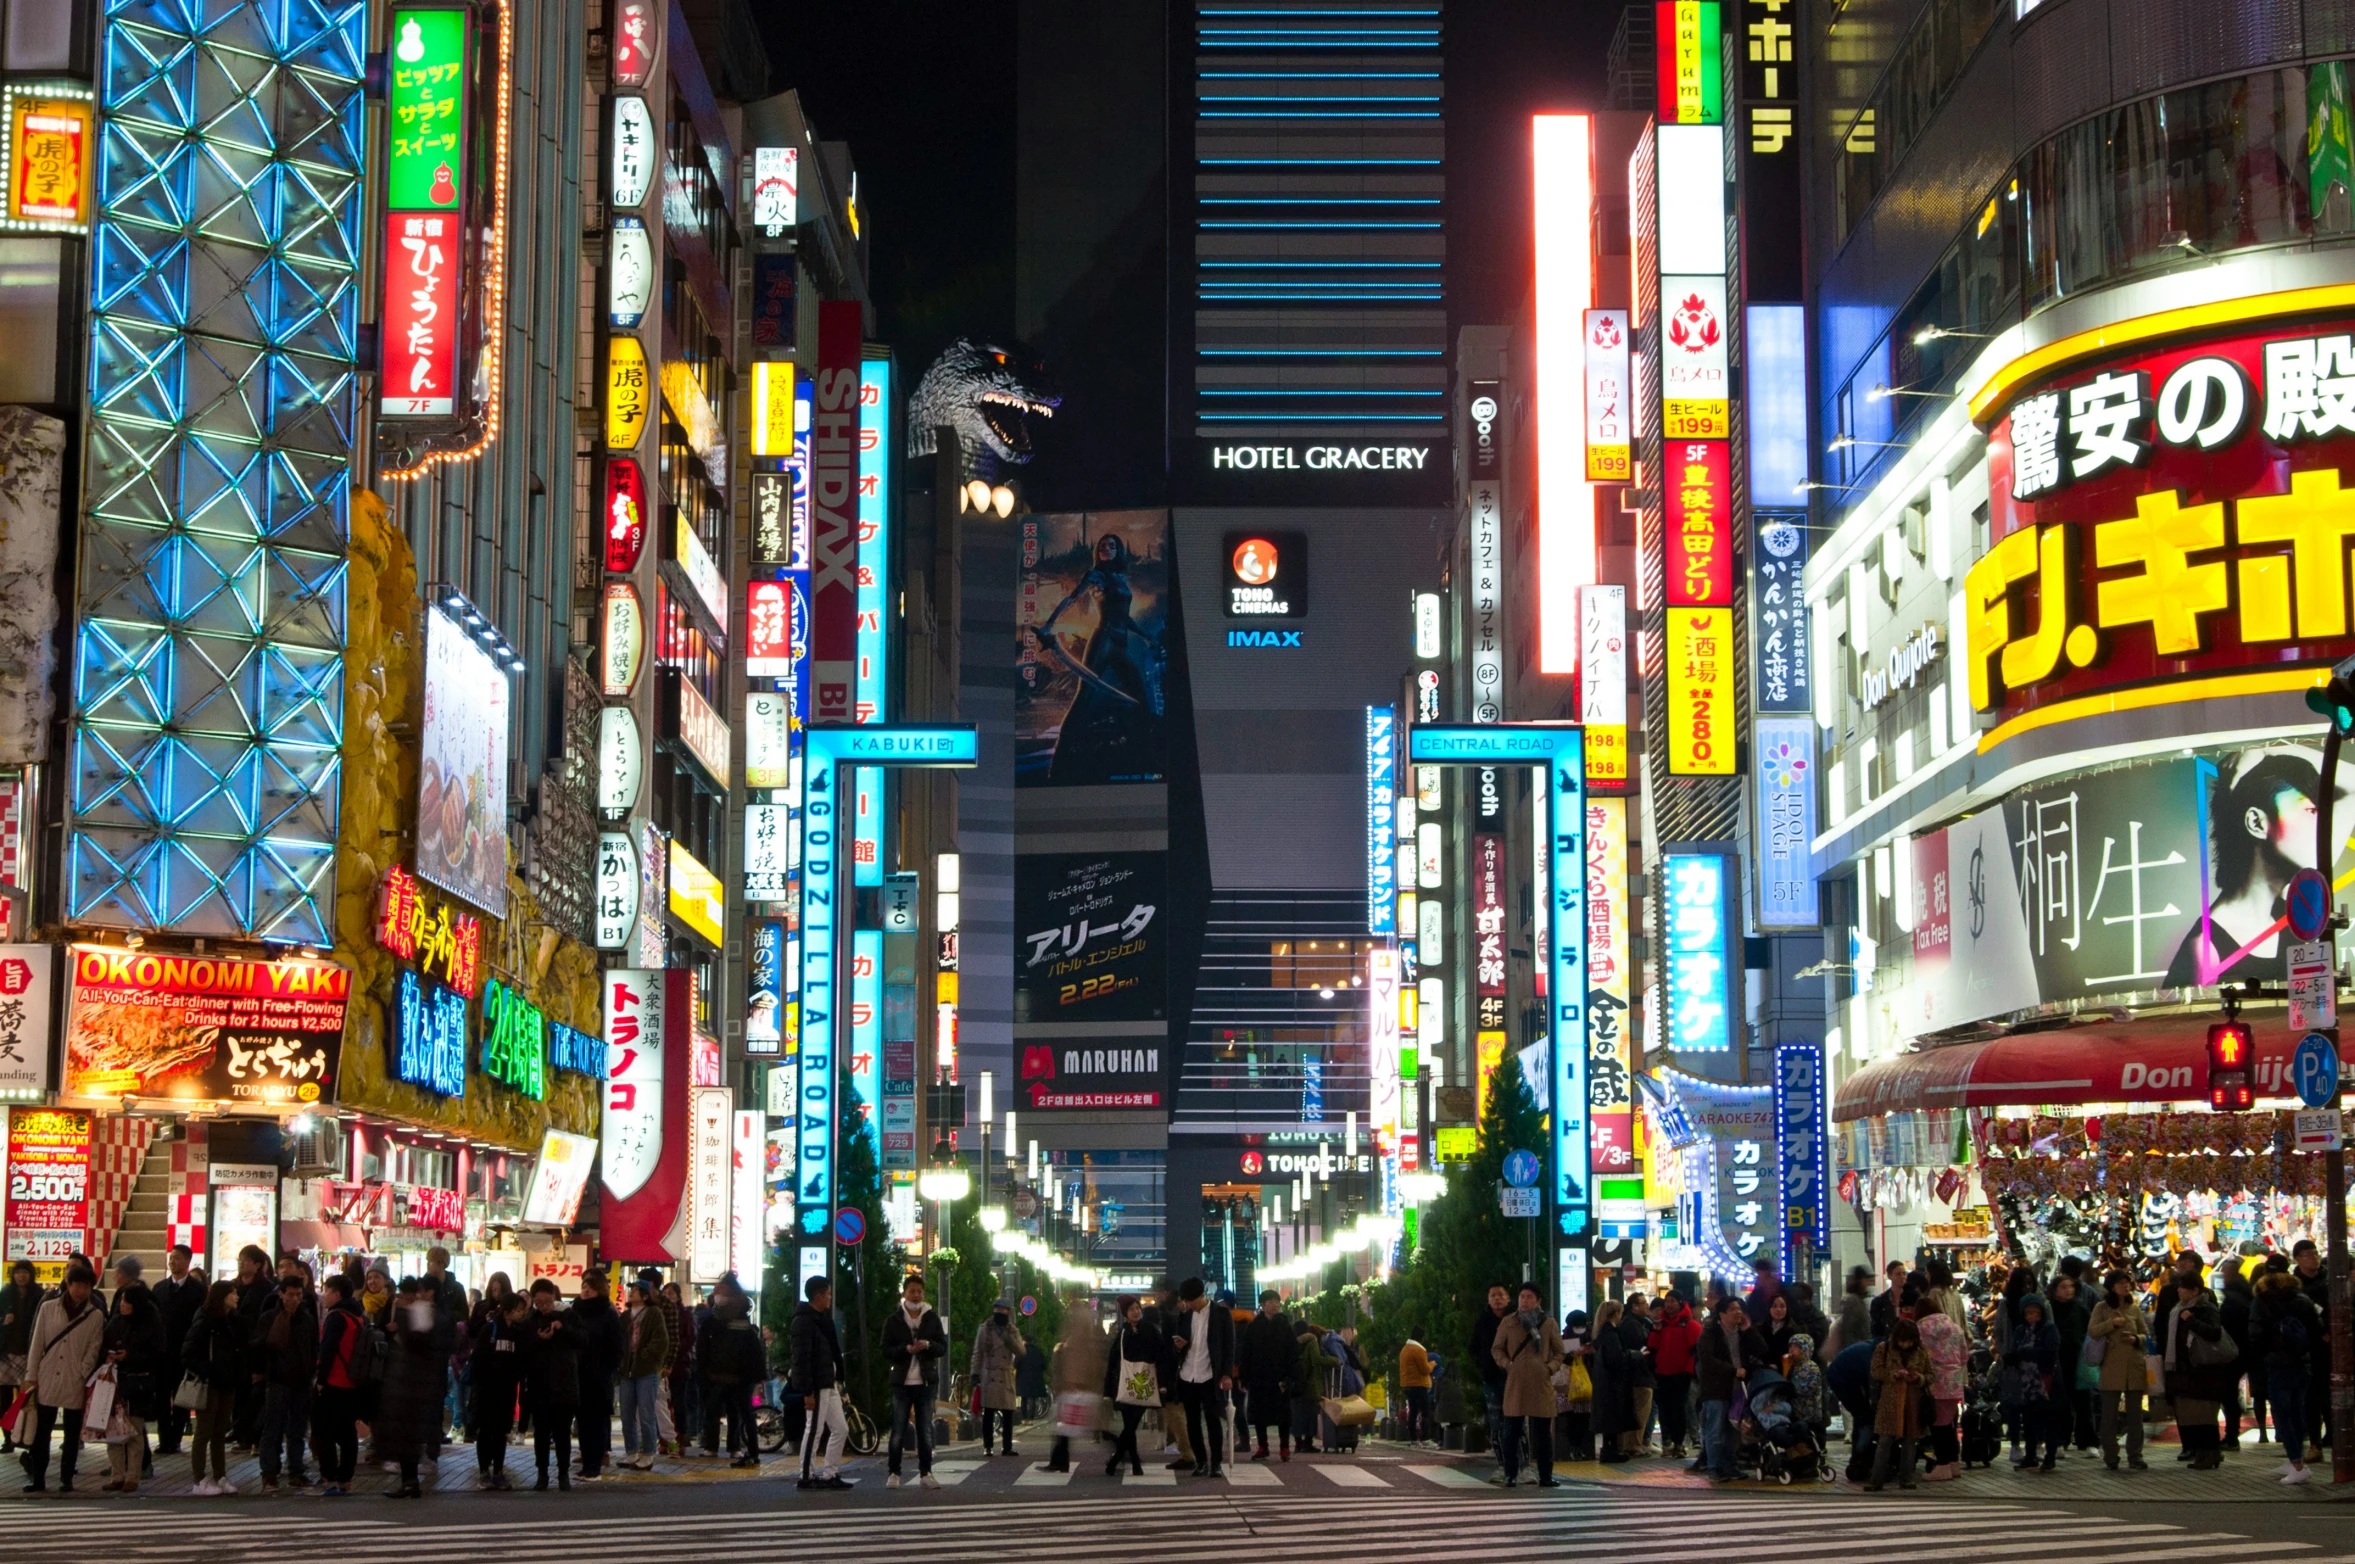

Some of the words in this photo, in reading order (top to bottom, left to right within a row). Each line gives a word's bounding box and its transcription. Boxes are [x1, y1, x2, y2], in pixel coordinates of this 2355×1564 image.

[619, 73, 641, 83] 7F
[420, 87, 432, 100] と
[18, 100, 49, 113] 4F
[397, 98, 455, 123] サラダ
[419, 122, 432, 134] と
[395, 133, 457, 157] スイーツ
[33, 138, 64, 193] 虎の子
[615, 188, 641, 204] 6F
[405, 219, 443, 237] 新宿
[766, 225, 783, 237] 8F
[401, 238, 445, 393] ひょうたん
[617, 315, 634, 325] 5F
[1670, 367, 1722, 383] 鳥メロ
[408, 400, 430, 412] 7F
[614, 368, 644, 423] 虎の子
[1598, 379, 1618, 439] 鳥メロ
[1670, 403, 1722, 415] 生ビール
[2011, 334, 2355, 500] 驚安の殿
[1678, 418, 1713, 434] 199
[611, 434, 631, 445] 4F
[1591, 447, 1626, 456] 生ビール
[1213, 447, 1300, 470] HOTEL
[1306, 447, 1429, 470] GRACERY
[1595, 457, 1627, 470] 199
[1686, 445, 1707, 462] 5F
[817, 368, 858, 594] SHIDAX
[756, 477, 783, 549] 山内農場
[632, 528, 641, 552] 3F
[1680, 465, 1715, 600] 豊後高田どり
[763, 551, 777, 560] 5F
[1232, 588, 1273, 601] TOHO
[1609, 589, 1623, 599] 4F
[1232, 602, 1289, 613] CINEMAS
[855, 384, 880, 862] カラオケ&パーテー館
[1762, 561, 1789, 701] かんかん商店
[613, 602, 630, 684] お好み焼き
[1228, 631, 1301, 647] IMAX
[1685, 636, 1718, 683] 酒場
[1863, 664, 1886, 711] Don
[1889, 622, 1939, 689] Quijote
[1480, 669, 1495, 679] 8F
[1689, 689, 1713, 699] 全品
[1481, 708, 1496, 719] 5F
[1691, 701, 1712, 760] 280
[1373, 716, 1393, 777] 747
[1420, 738, 1501, 750] CENTRAL
[1507, 738, 1554, 750] ROAD
[612, 731, 628, 803] とらそば
[757, 769, 778, 783] 3F
[606, 809, 625, 820] 1F
[1771, 793, 1788, 860] STAGE
[1788, 793, 1804, 847] IDOL
[602, 841, 627, 852] 新宿
[1373, 786, 1393, 926] カラオケランド
[1484, 839, 1496, 904] 手作り居酒屋
[1586, 806, 1612, 949] きんくら酒場
[1772, 881, 1803, 901] 5F
[1914, 870, 1948, 922] 免税
[2015, 791, 2187, 986] 桐生
[805, 802, 833, 1027] GODZILLA
[603, 928, 624, 939] B1
[1026, 904, 1157, 969] アリータ
[1915, 927, 1930, 951] Tax
[1931, 922, 1949, 946] Free
[753, 928, 775, 988] 海の家
[1048, 939, 1146, 978] バトル・エンジェル
[1476, 906, 1506, 987] 甘太郎
[1675, 862, 1723, 1042] カラオケ
[81, 953, 255, 992] OKONOMI
[267, 963, 350, 997] YAKI
[1556, 834, 1580, 1137] ゴジラロード
[1060, 973, 1115, 1005] 2.22
[79, 988, 187, 1008] All-You-Can-Eat
[187, 996, 229, 1010] dinner
[232, 999, 259, 1012] with
[262, 999, 344, 1016] Free-Flowing
[643, 974, 661, 1049] 大衆酒場
[1480, 998, 1503, 1012] 4F
[184, 1012, 227, 1026] Drinks
[229, 1013, 248, 1026] for
[262, 1016, 299, 1029] hours
[302, 1017, 342, 1032] ¥2,500
[1480, 1013, 1503, 1027] 3F
[609, 983, 640, 1112] トラノコ
[1374, 976, 1397, 1106] マルハン
[1588, 988, 1630, 1108] 金の蔵
[1064, 1050, 1158, 1074] MARUHAN
[885, 1080, 912, 1091] Cafe
[2121, 1063, 2192, 1089] Don
[2302, 1051, 2319, 1098] P
[2315, 1075, 2328, 1096] 40
[302, 1087, 319, 1097] 2F
[804, 1054, 827, 1161] ROAD
[12, 1113, 89, 1132] お好み焼き
[1784, 1055, 1816, 1198] カラオケ
[888, 1139, 909, 1148] 729
[215, 1169, 275, 1180] 防犯カメラ作動中
[705, 1137, 720, 1207] 珈琲茶館
[1267, 1155, 1320, 1173] TOHO
[11, 1176, 84, 1202] 2,500円
[1732, 1140, 1765, 1257] カラオケ
[700, 1217, 723, 1240] 集
[1787, 1206, 1816, 1228] B1
[532, 1263, 583, 1277] トラノコ
